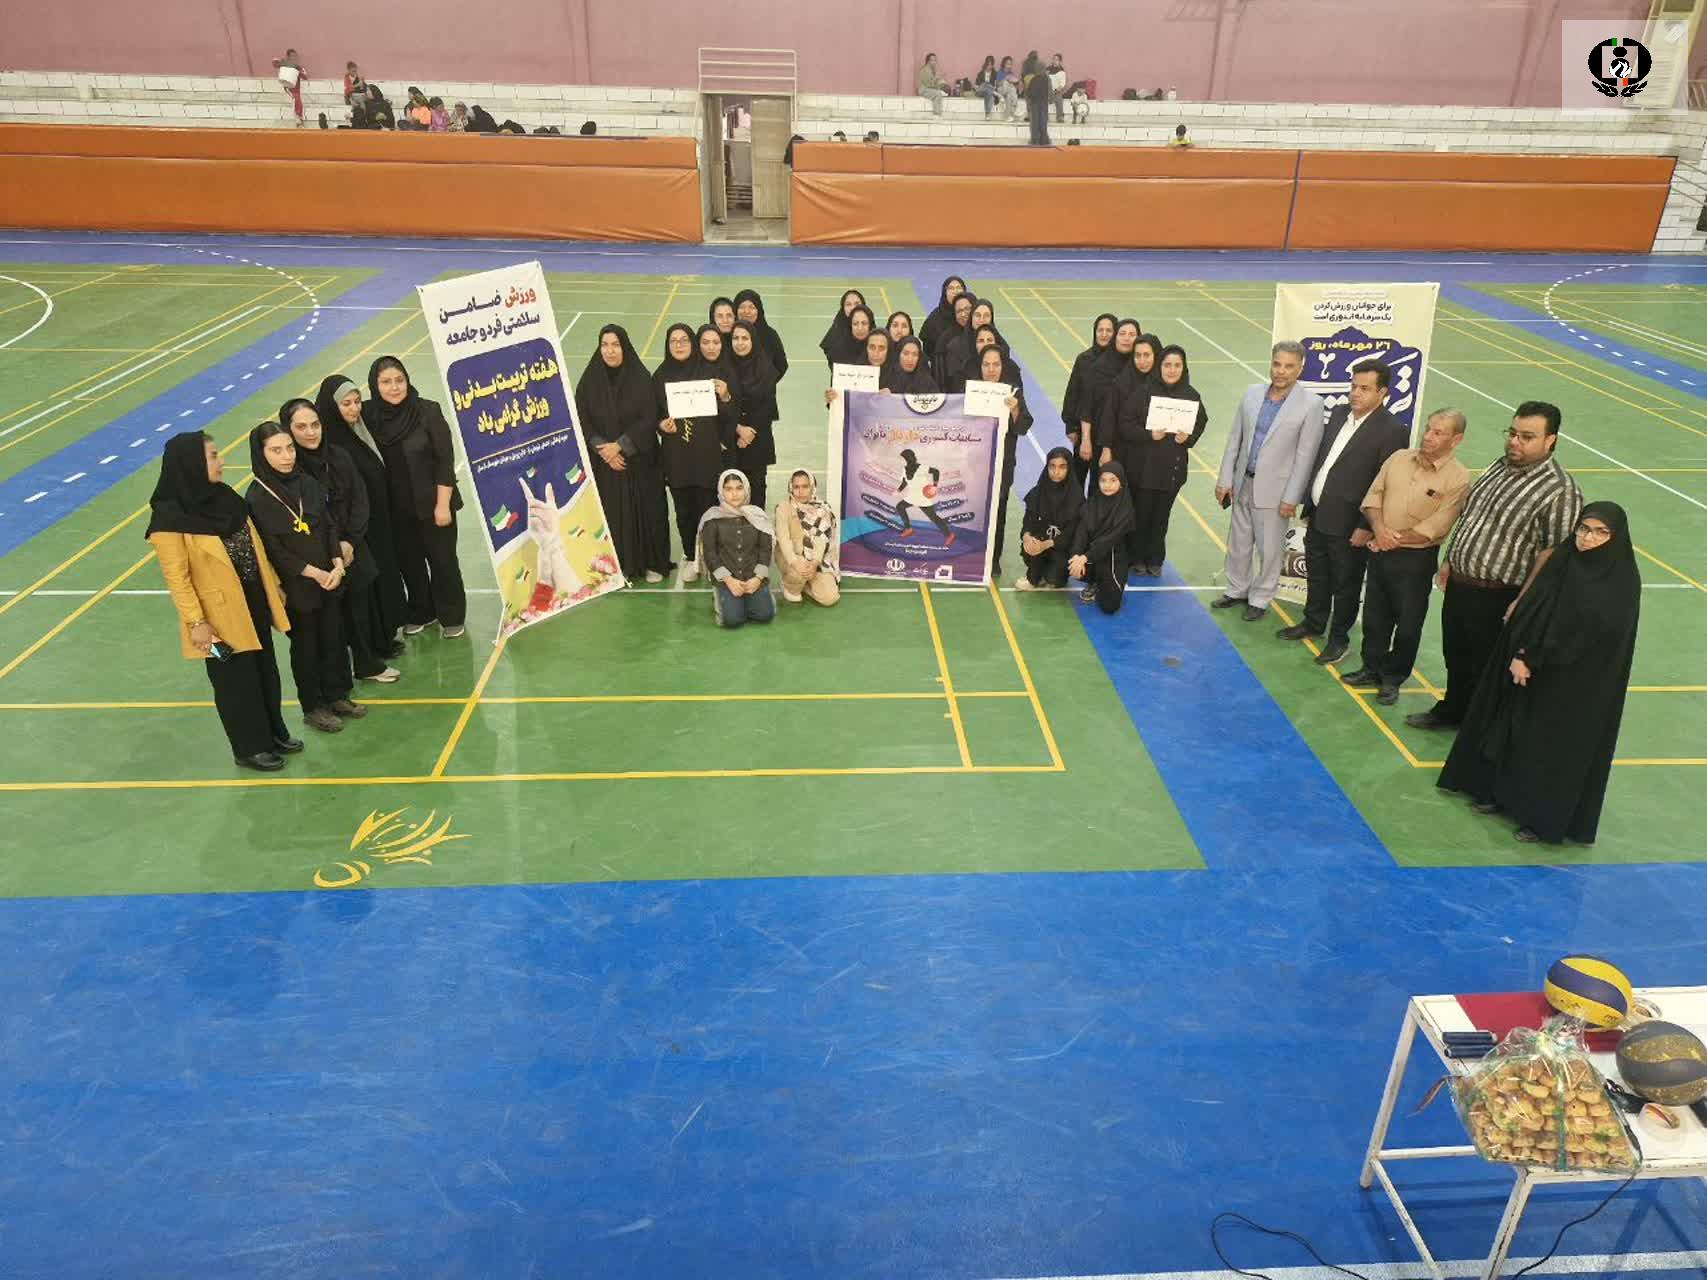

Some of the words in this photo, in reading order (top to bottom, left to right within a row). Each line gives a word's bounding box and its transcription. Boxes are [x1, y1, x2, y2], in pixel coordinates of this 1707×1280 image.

[440, 289, 502, 324] ضامن
[504, 286, 537, 308] ورزش
[1352, 302, 1377, 311] جوانان
[1377, 302, 1392, 311] برای
[487, 313, 502, 338] فرد
[503, 311, 540, 335] سلامتی
[1381, 313, 1392, 321] یک
[446, 326, 478, 345] جامعه
[479, 327, 488, 341] و
[1308, 341, 1327, 350] روز
[495, 362, 529, 391] تربیت
[529, 356, 558, 381] هفته
[453, 390, 463, 410] و
[462, 377, 498, 409] بدنی
[494, 398, 521, 434] گرامی
[521, 394, 549, 424] ورزش
[477, 410, 494, 436] باد
